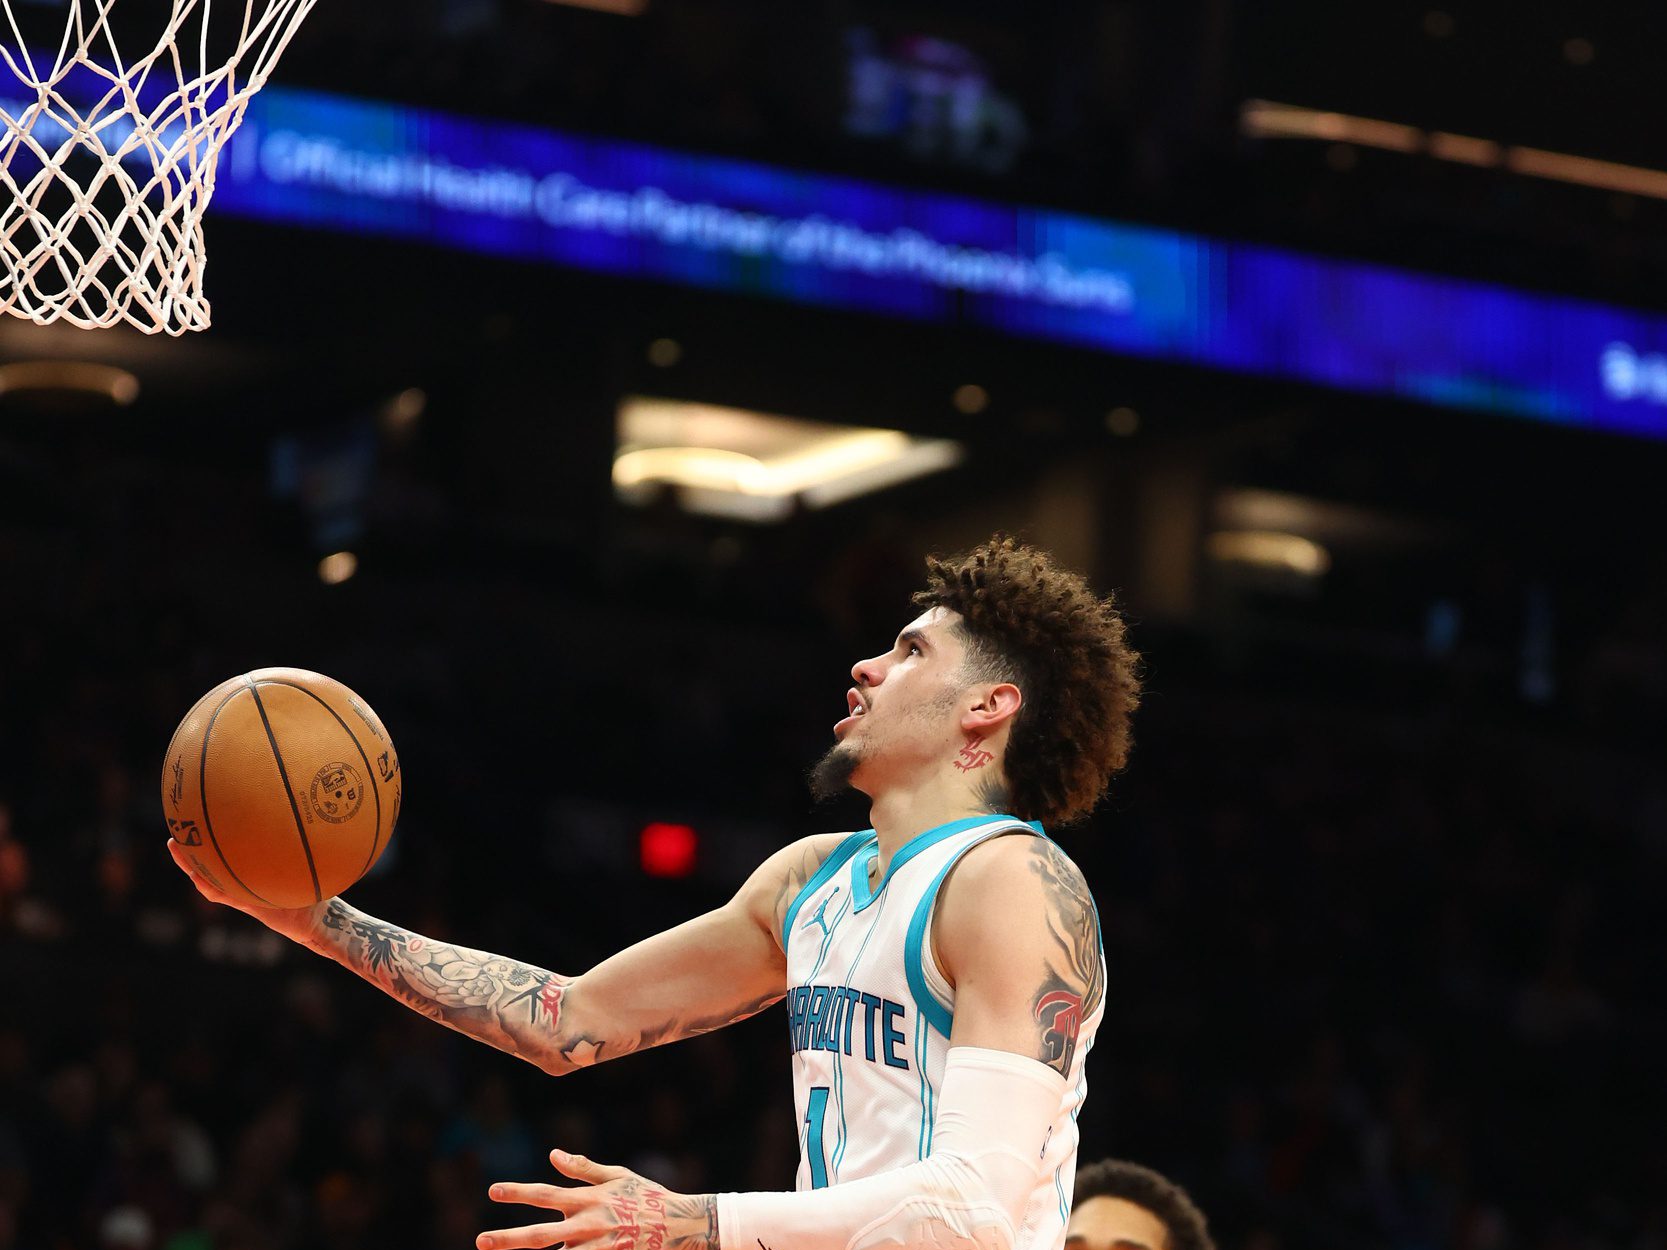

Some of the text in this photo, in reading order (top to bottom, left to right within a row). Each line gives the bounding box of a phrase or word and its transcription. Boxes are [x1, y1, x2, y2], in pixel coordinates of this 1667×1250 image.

[262, 130, 403, 198] Official
[412, 154, 536, 219] Health
[538, 172, 632, 236] Care
[634, 186, 776, 255] Partner
[890, 228, 1037, 298] Phoenix
[1037, 242, 1135, 312] Suns
[805, 1086, 830, 1190] 1
[642, 1187, 667, 1219] NOT
